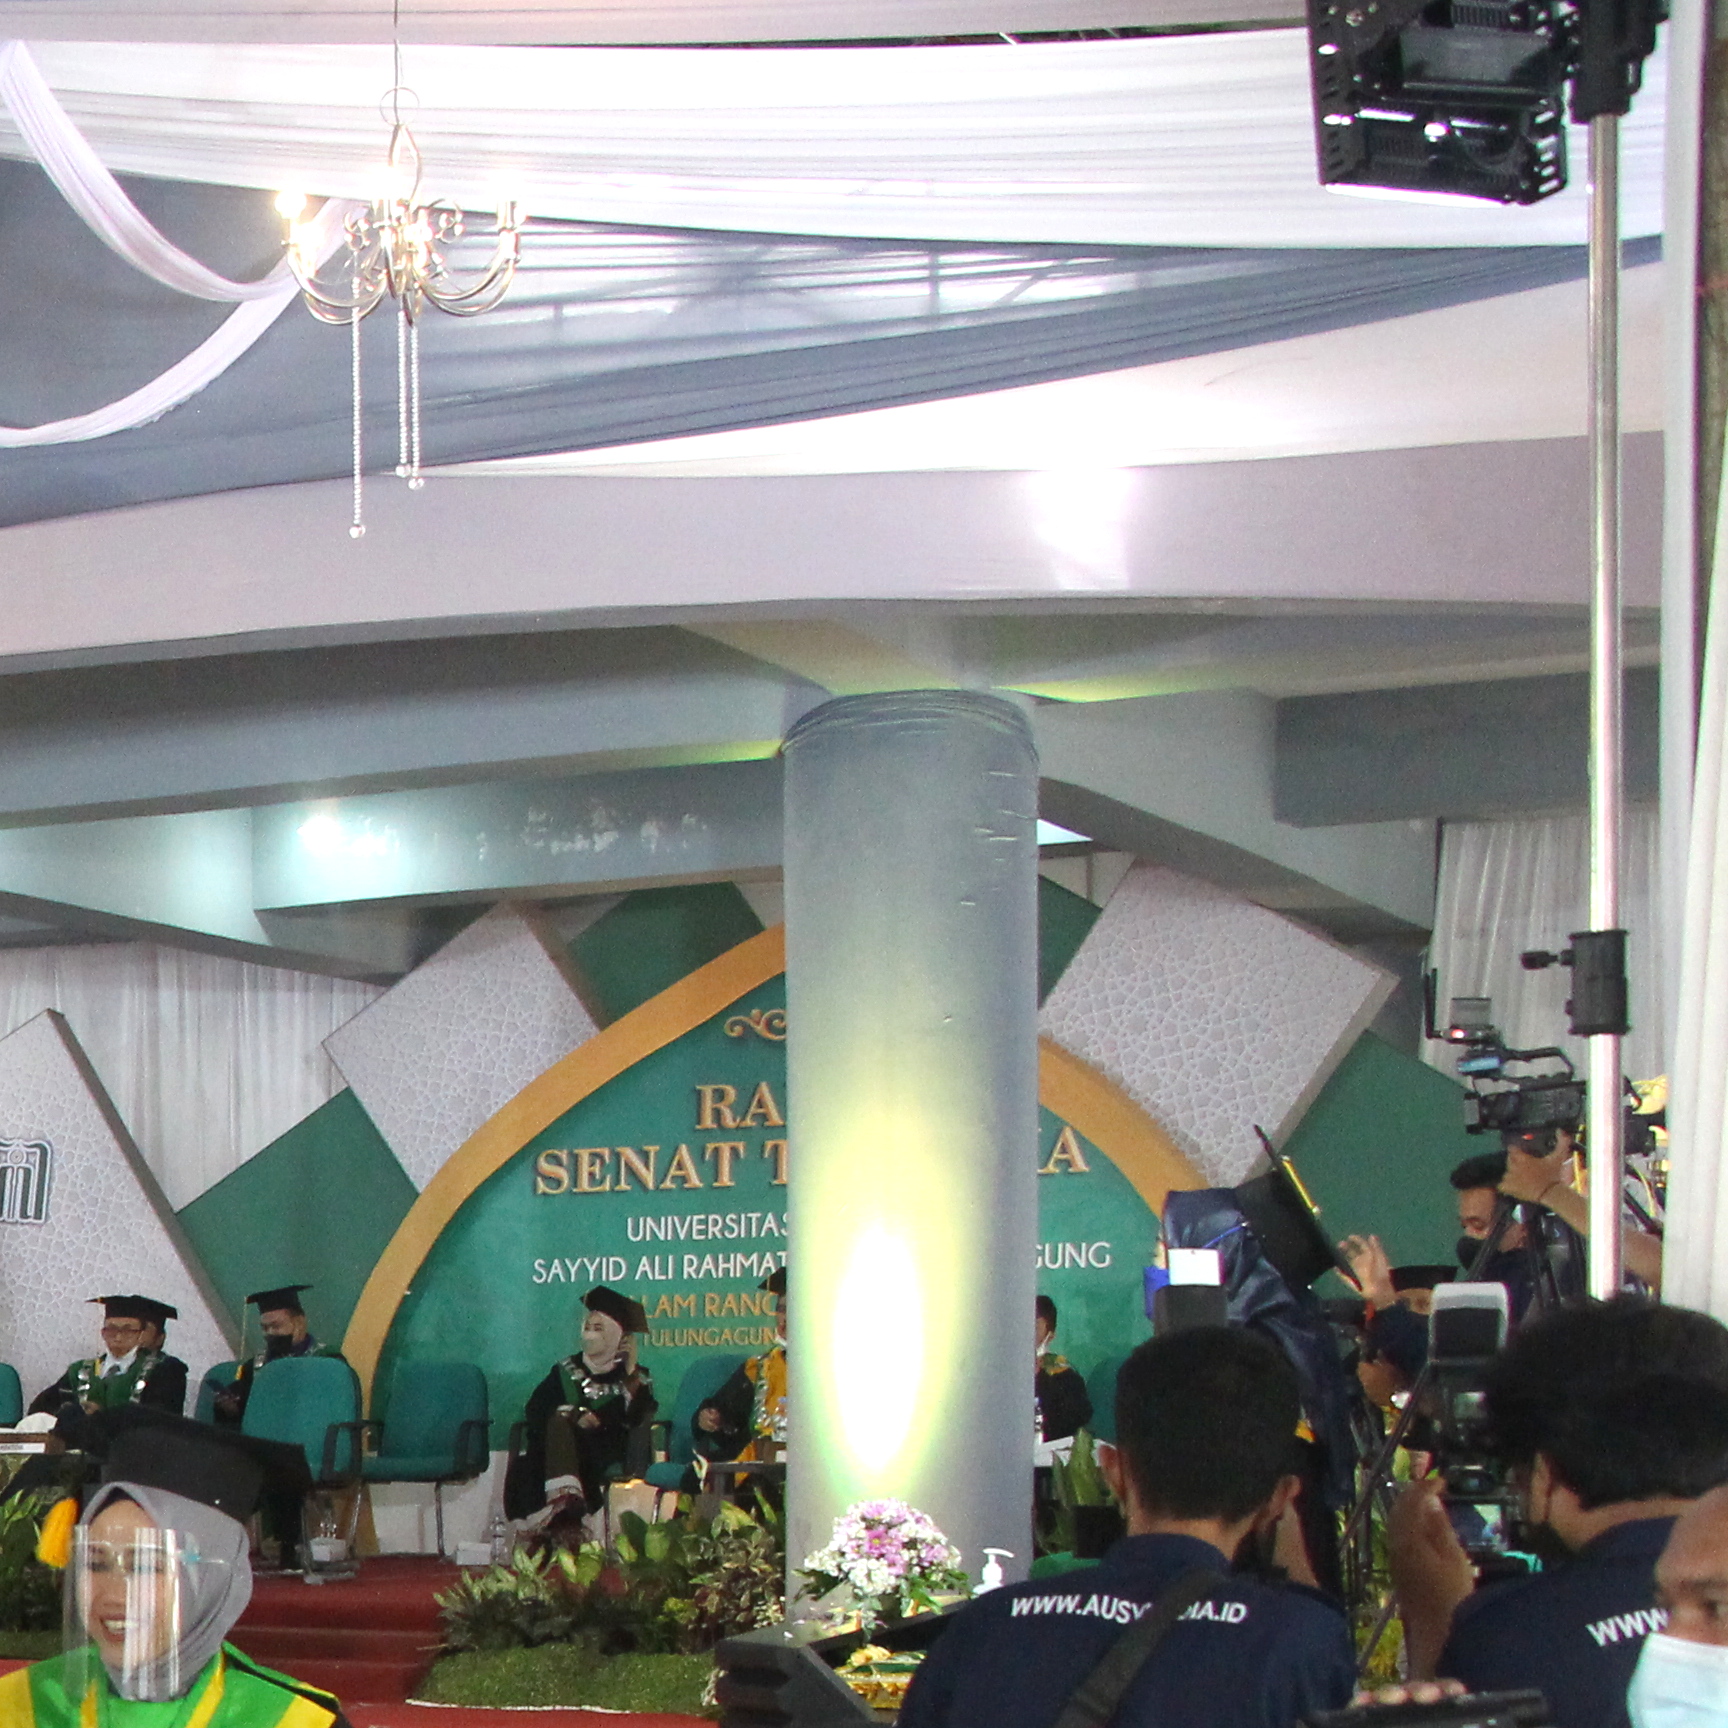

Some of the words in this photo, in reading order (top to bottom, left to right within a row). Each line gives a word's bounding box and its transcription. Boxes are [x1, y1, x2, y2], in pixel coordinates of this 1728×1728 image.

[695, 1081, 787, 1129] RA
[535, 1142, 746, 1195] SENAT
[532, 1256, 627, 1284] SAYYID
[635, 1254, 674, 1280] ALI
[683, 1251, 787, 1280] RAHMAT
[1584, 1606, 1671, 1648] WWW
